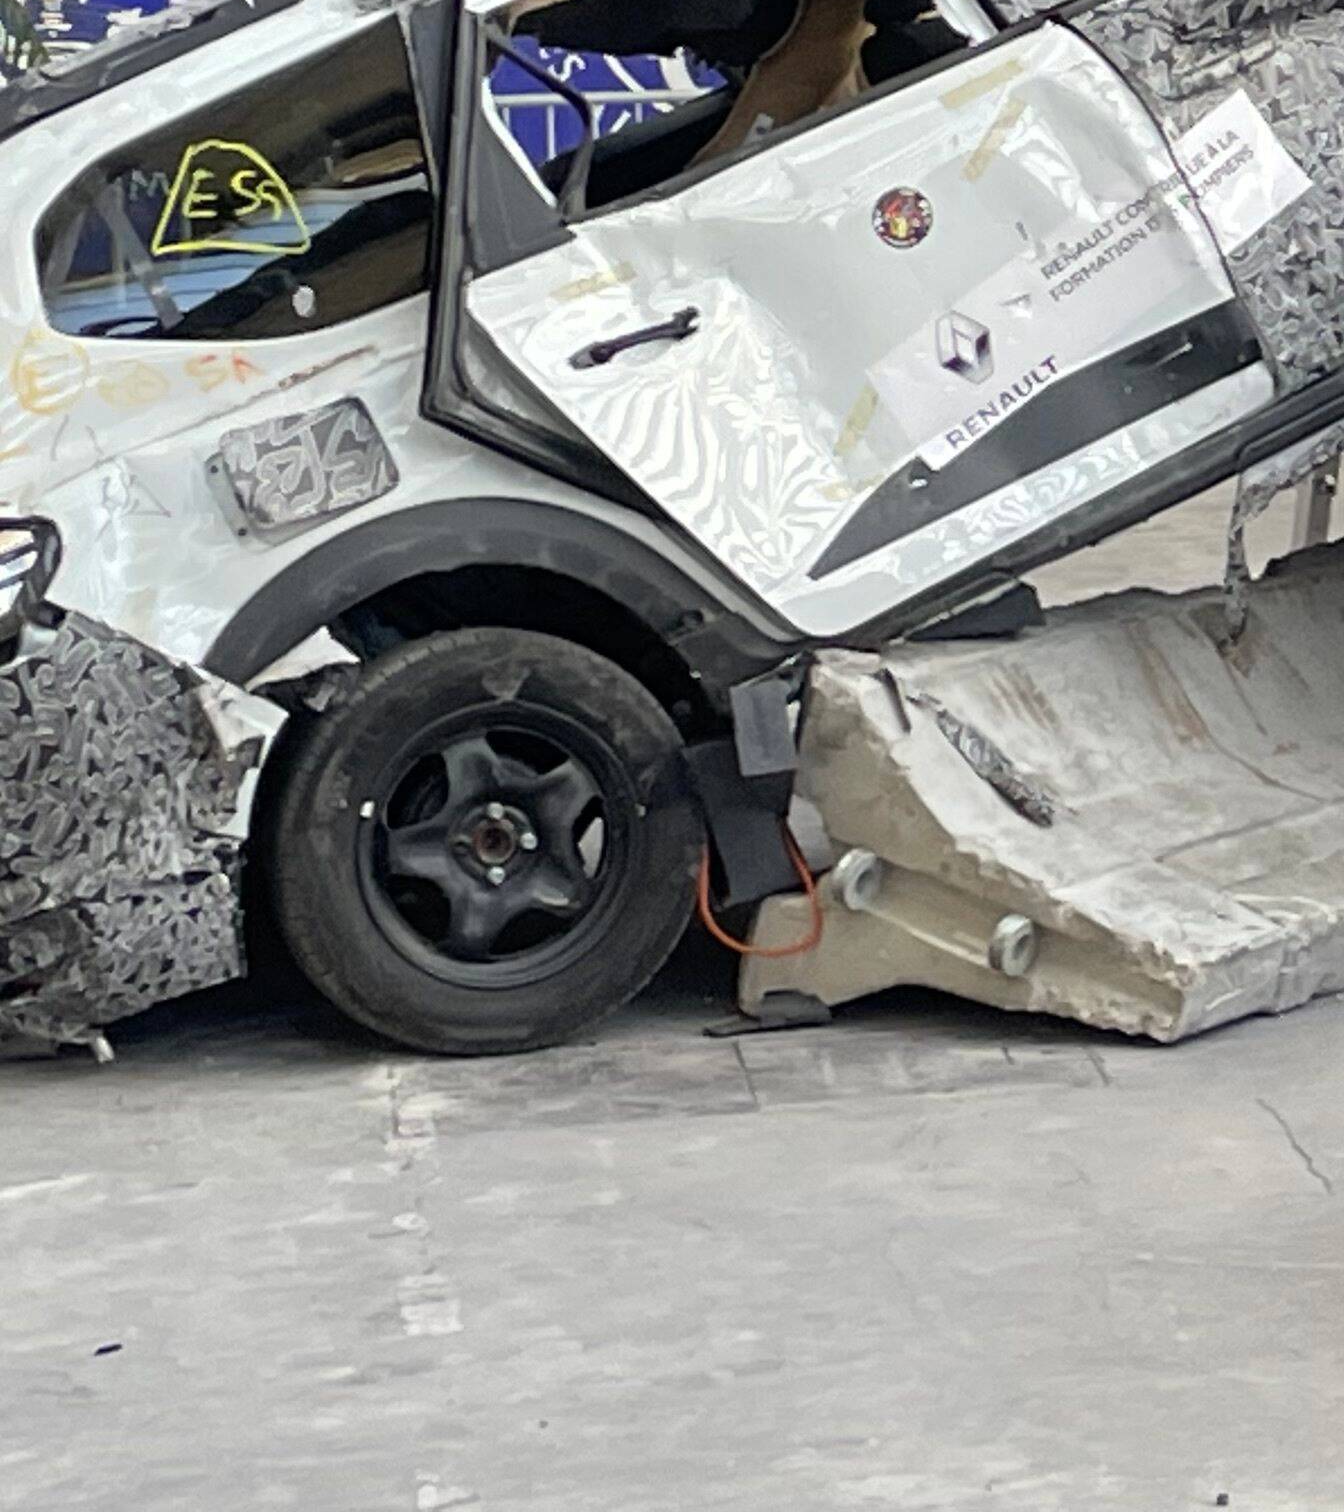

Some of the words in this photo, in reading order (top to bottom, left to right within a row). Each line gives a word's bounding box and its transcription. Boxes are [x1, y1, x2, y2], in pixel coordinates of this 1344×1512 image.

[1041, 219, 1114, 279] RENAULT
[1049, 227, 1147, 301] FORMATION
[945, 354, 1058, 448] RENAULT
